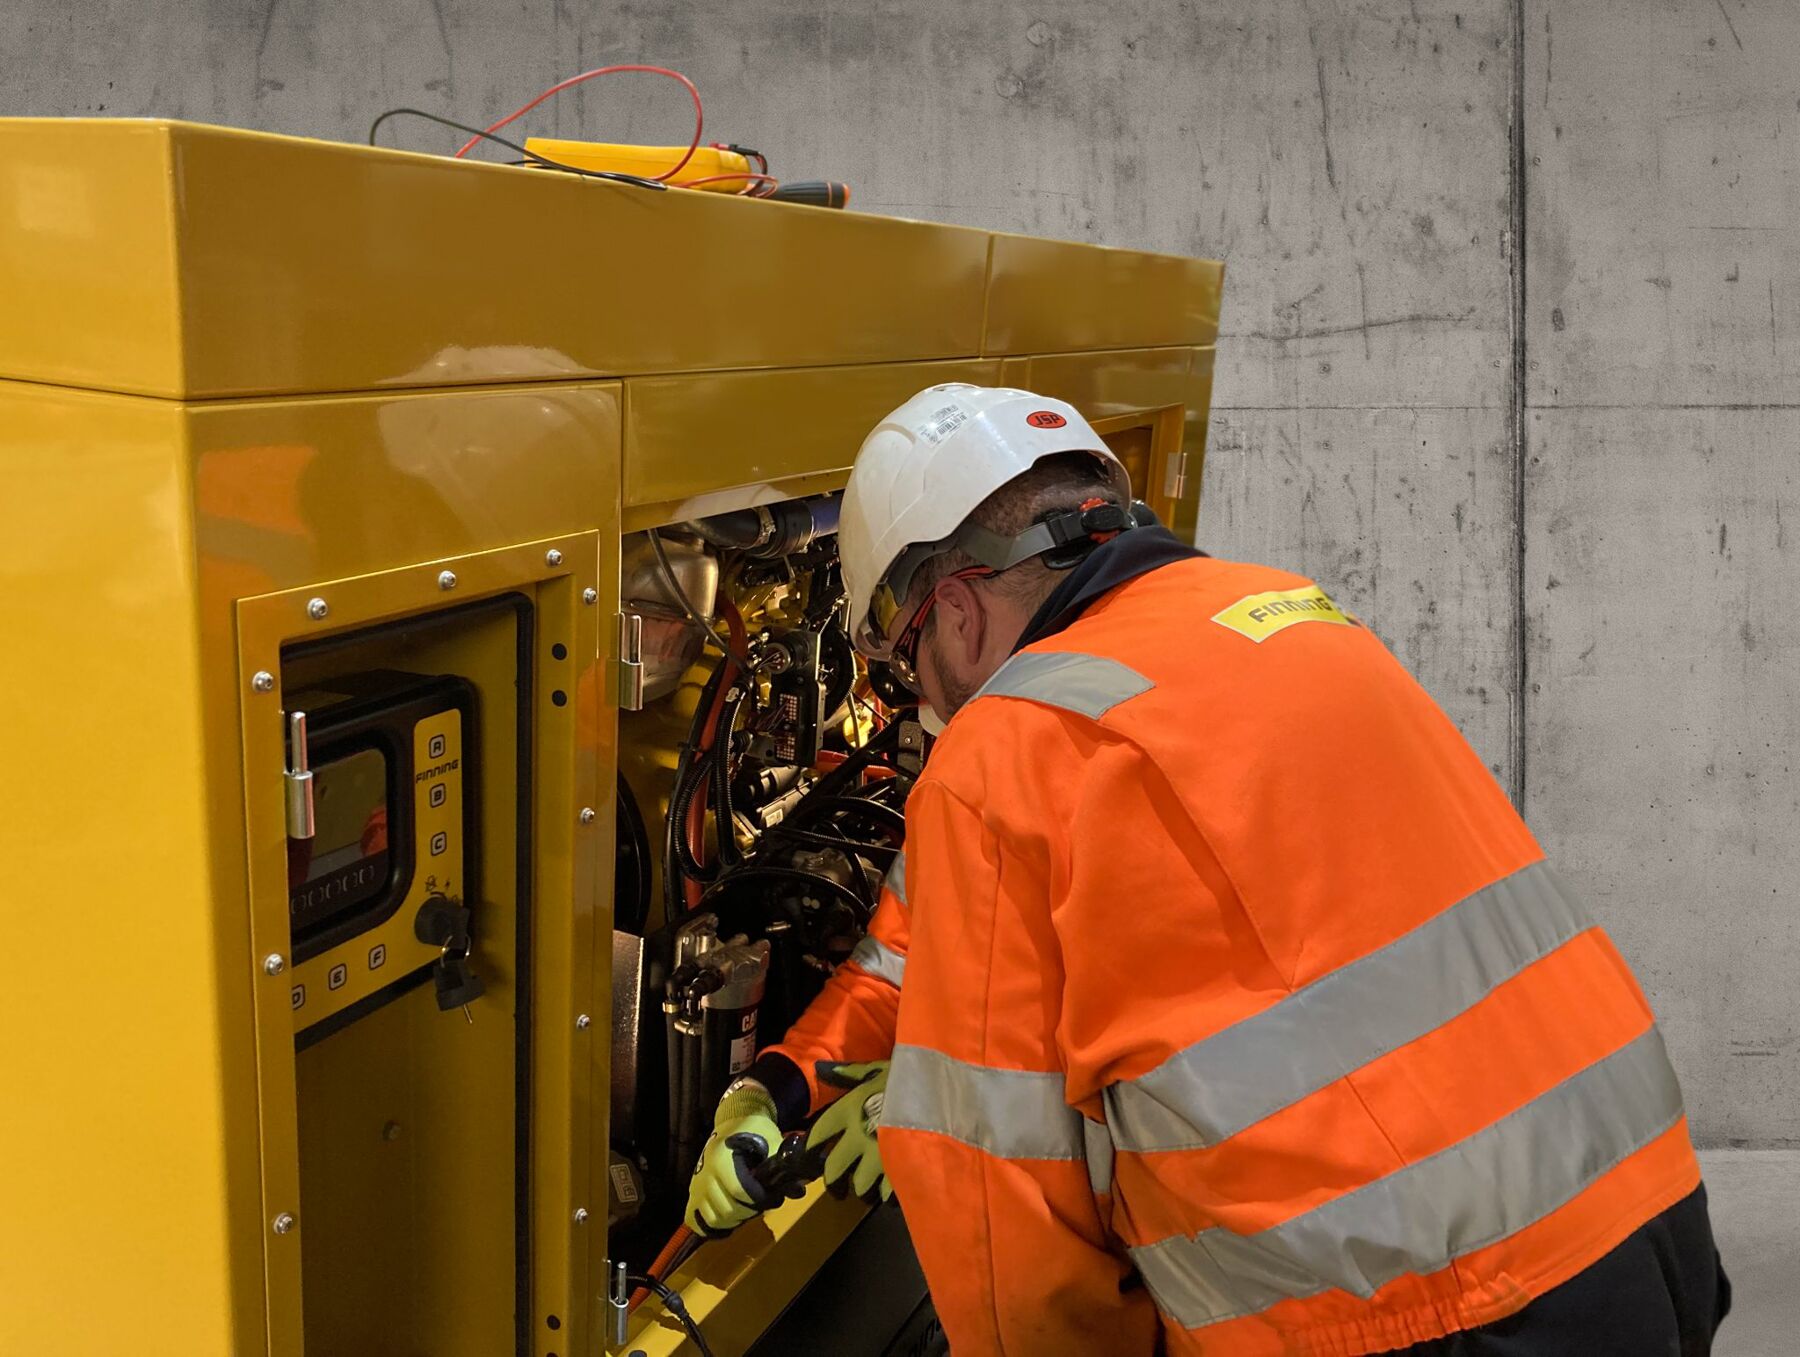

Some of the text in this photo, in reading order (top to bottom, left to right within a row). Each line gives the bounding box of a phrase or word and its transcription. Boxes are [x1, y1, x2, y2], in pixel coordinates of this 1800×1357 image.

[1036, 414, 1060, 425] JSP
[1248, 597, 1332, 622] FINNING
[415, 759, 459, 784] FINNING
